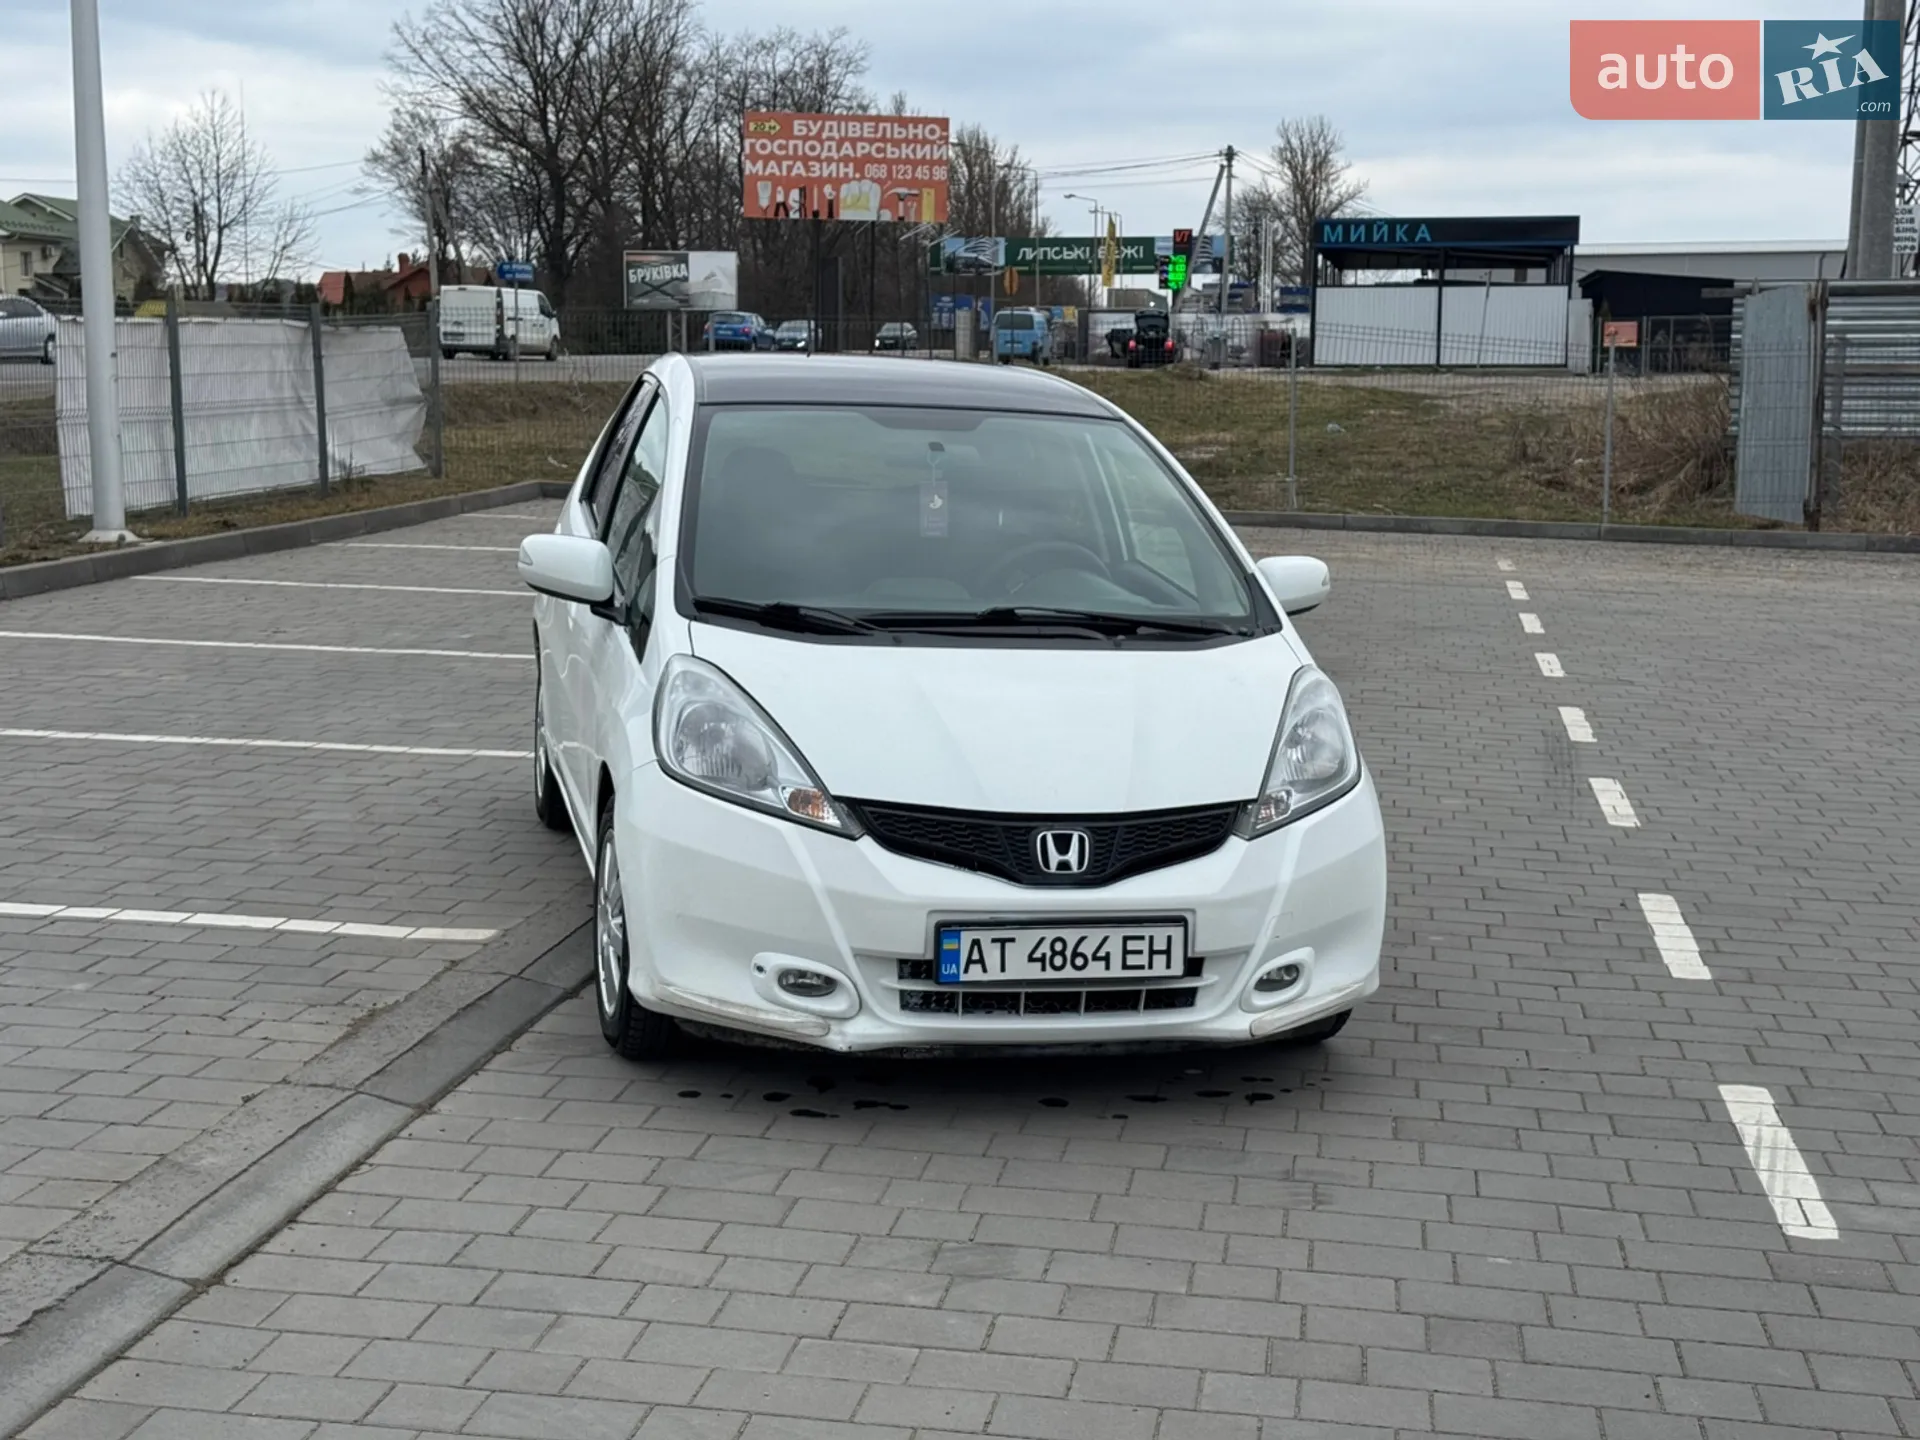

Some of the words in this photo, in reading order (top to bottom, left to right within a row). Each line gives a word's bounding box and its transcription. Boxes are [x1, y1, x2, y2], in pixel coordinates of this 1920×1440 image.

[793, 119, 948, 141] БУДІВЕЛЬНО-
[744, 138, 948, 161] ГОСПОДАРСЬКИЙ
[744, 159, 861, 179] МАГАЗИН.
[864, 163, 888, 179] 068
[891, 164, 913, 180] 123
[915, 164, 930, 180] 45
[1323, 220, 1432, 243] МИЙКА
[628, 263, 689, 283] БРУКІВКА
[963, 937, 1016, 974] AT
[1027, 935, 1110, 972] 4864
[941, 963, 957, 975] UA
